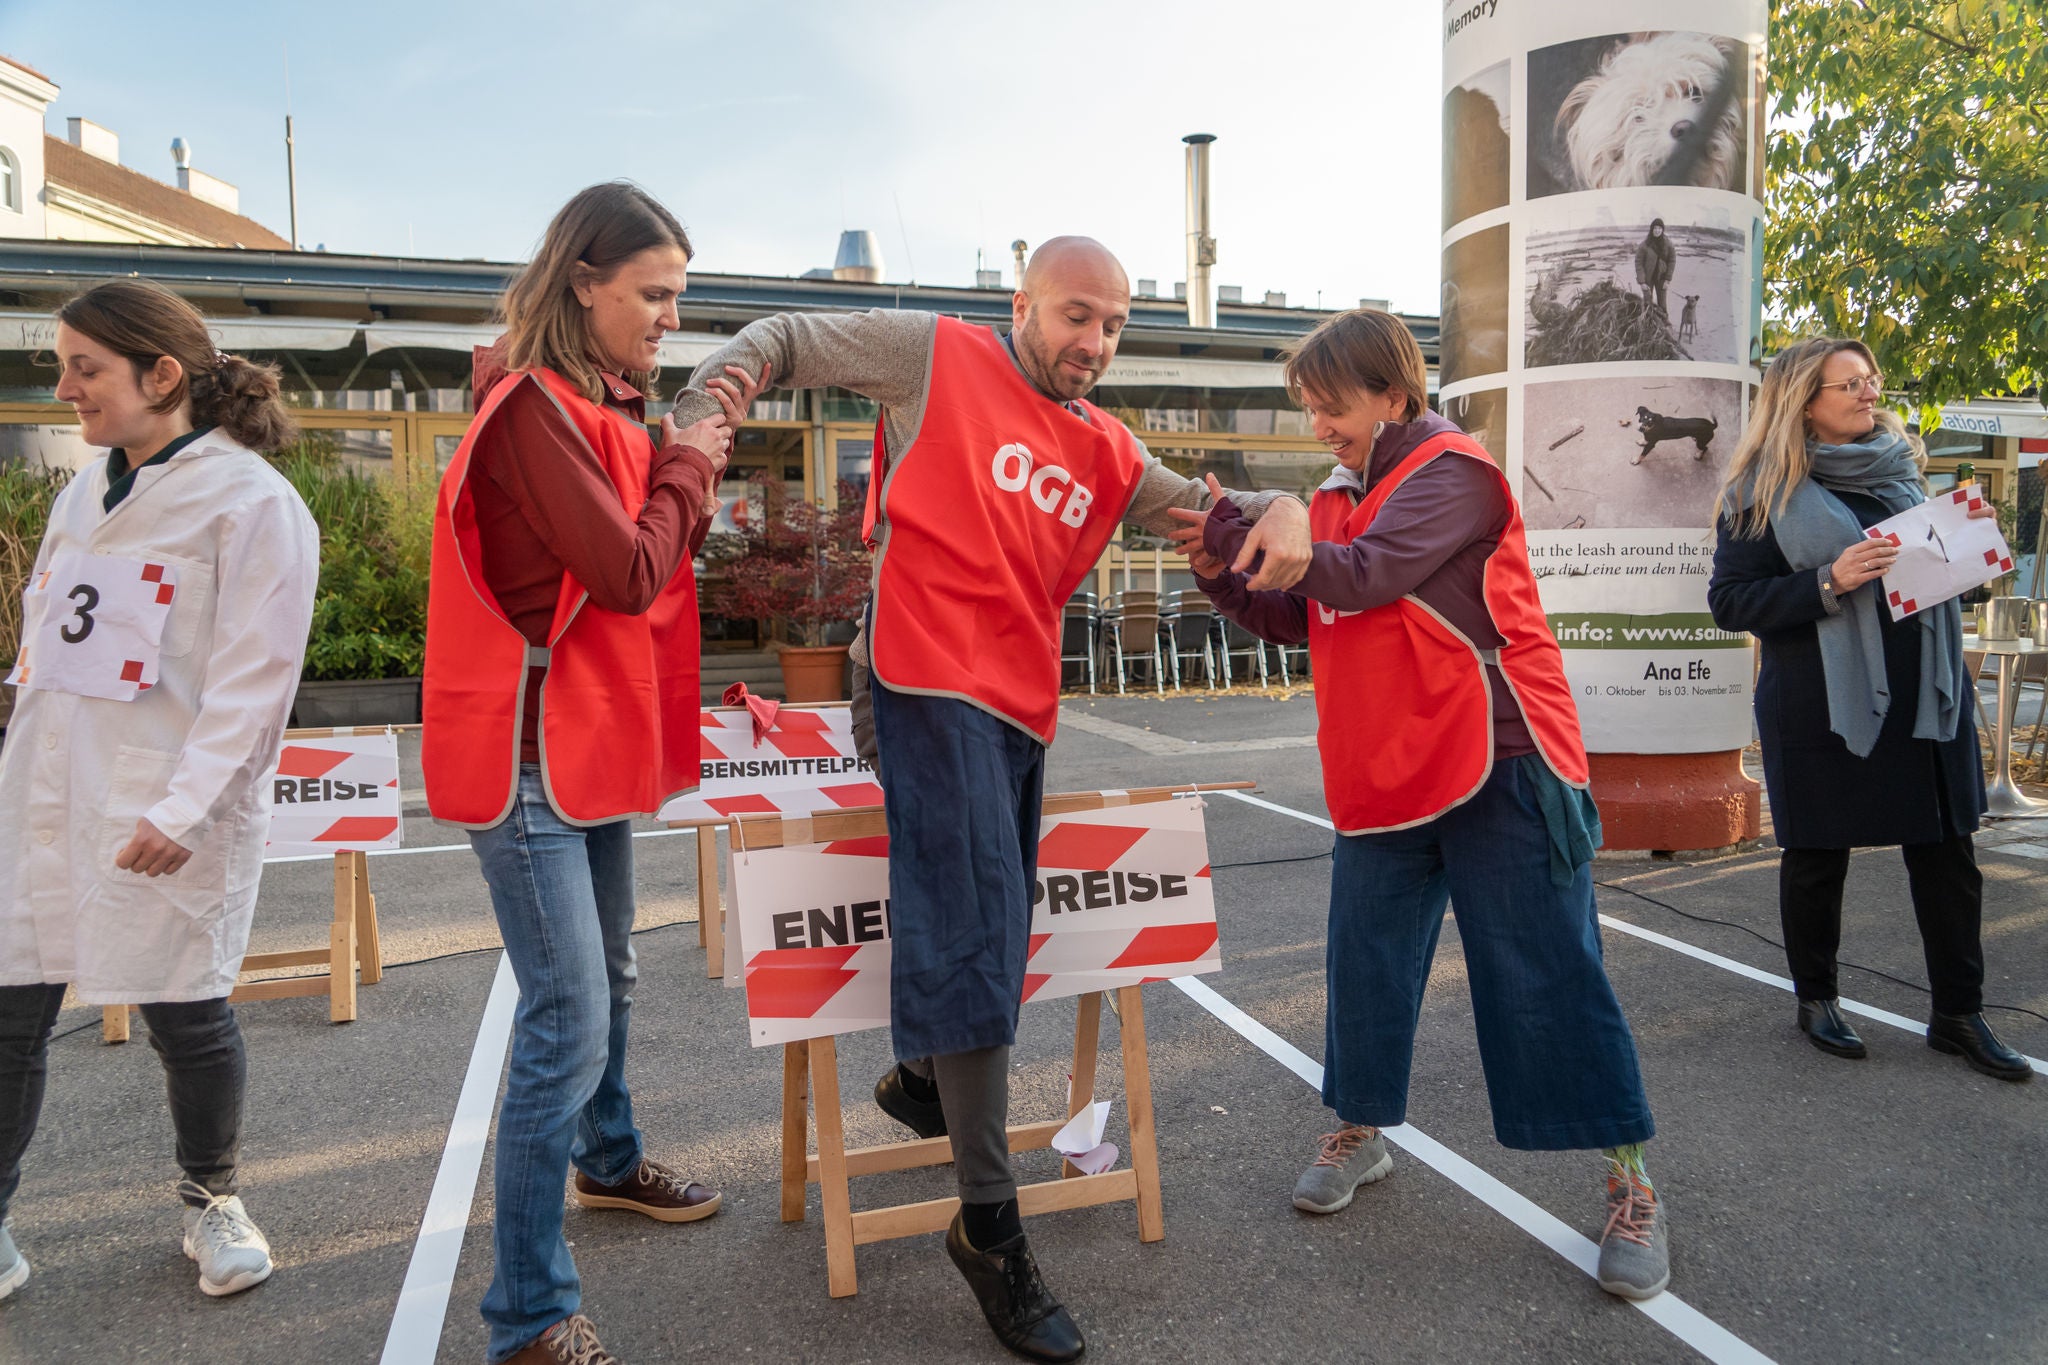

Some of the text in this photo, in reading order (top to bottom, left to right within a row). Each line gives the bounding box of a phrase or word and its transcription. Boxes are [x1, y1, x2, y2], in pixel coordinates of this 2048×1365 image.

[1447, 0, 1498, 42] Memory
[1550, 543, 1573, 557] the
[1578, 542, 1616, 557] leash
[1620, 542, 1675, 556] around
[1678, 542, 1699, 556] the
[1558, 562, 1580, 576] die
[1584, 563, 1622, 576] Leine
[1626, 565, 1648, 575] um
[1652, 562, 1676, 575] den
[1680, 562, 1709, 577] Hals,
[61, 584, 100, 644] 3
[1557, 621, 1613, 641] info:
[1643, 659, 1711, 680] Ana Efe
[1585, 685, 1603, 696] 01.
[1606, 685, 1647, 696] Oktober
[1658, 685, 1672, 696] bis
[1674, 686, 1690, 696] 03.
[1692, 684, 1727, 696] November
[700, 757, 874, 779] BENSMITTELPR
